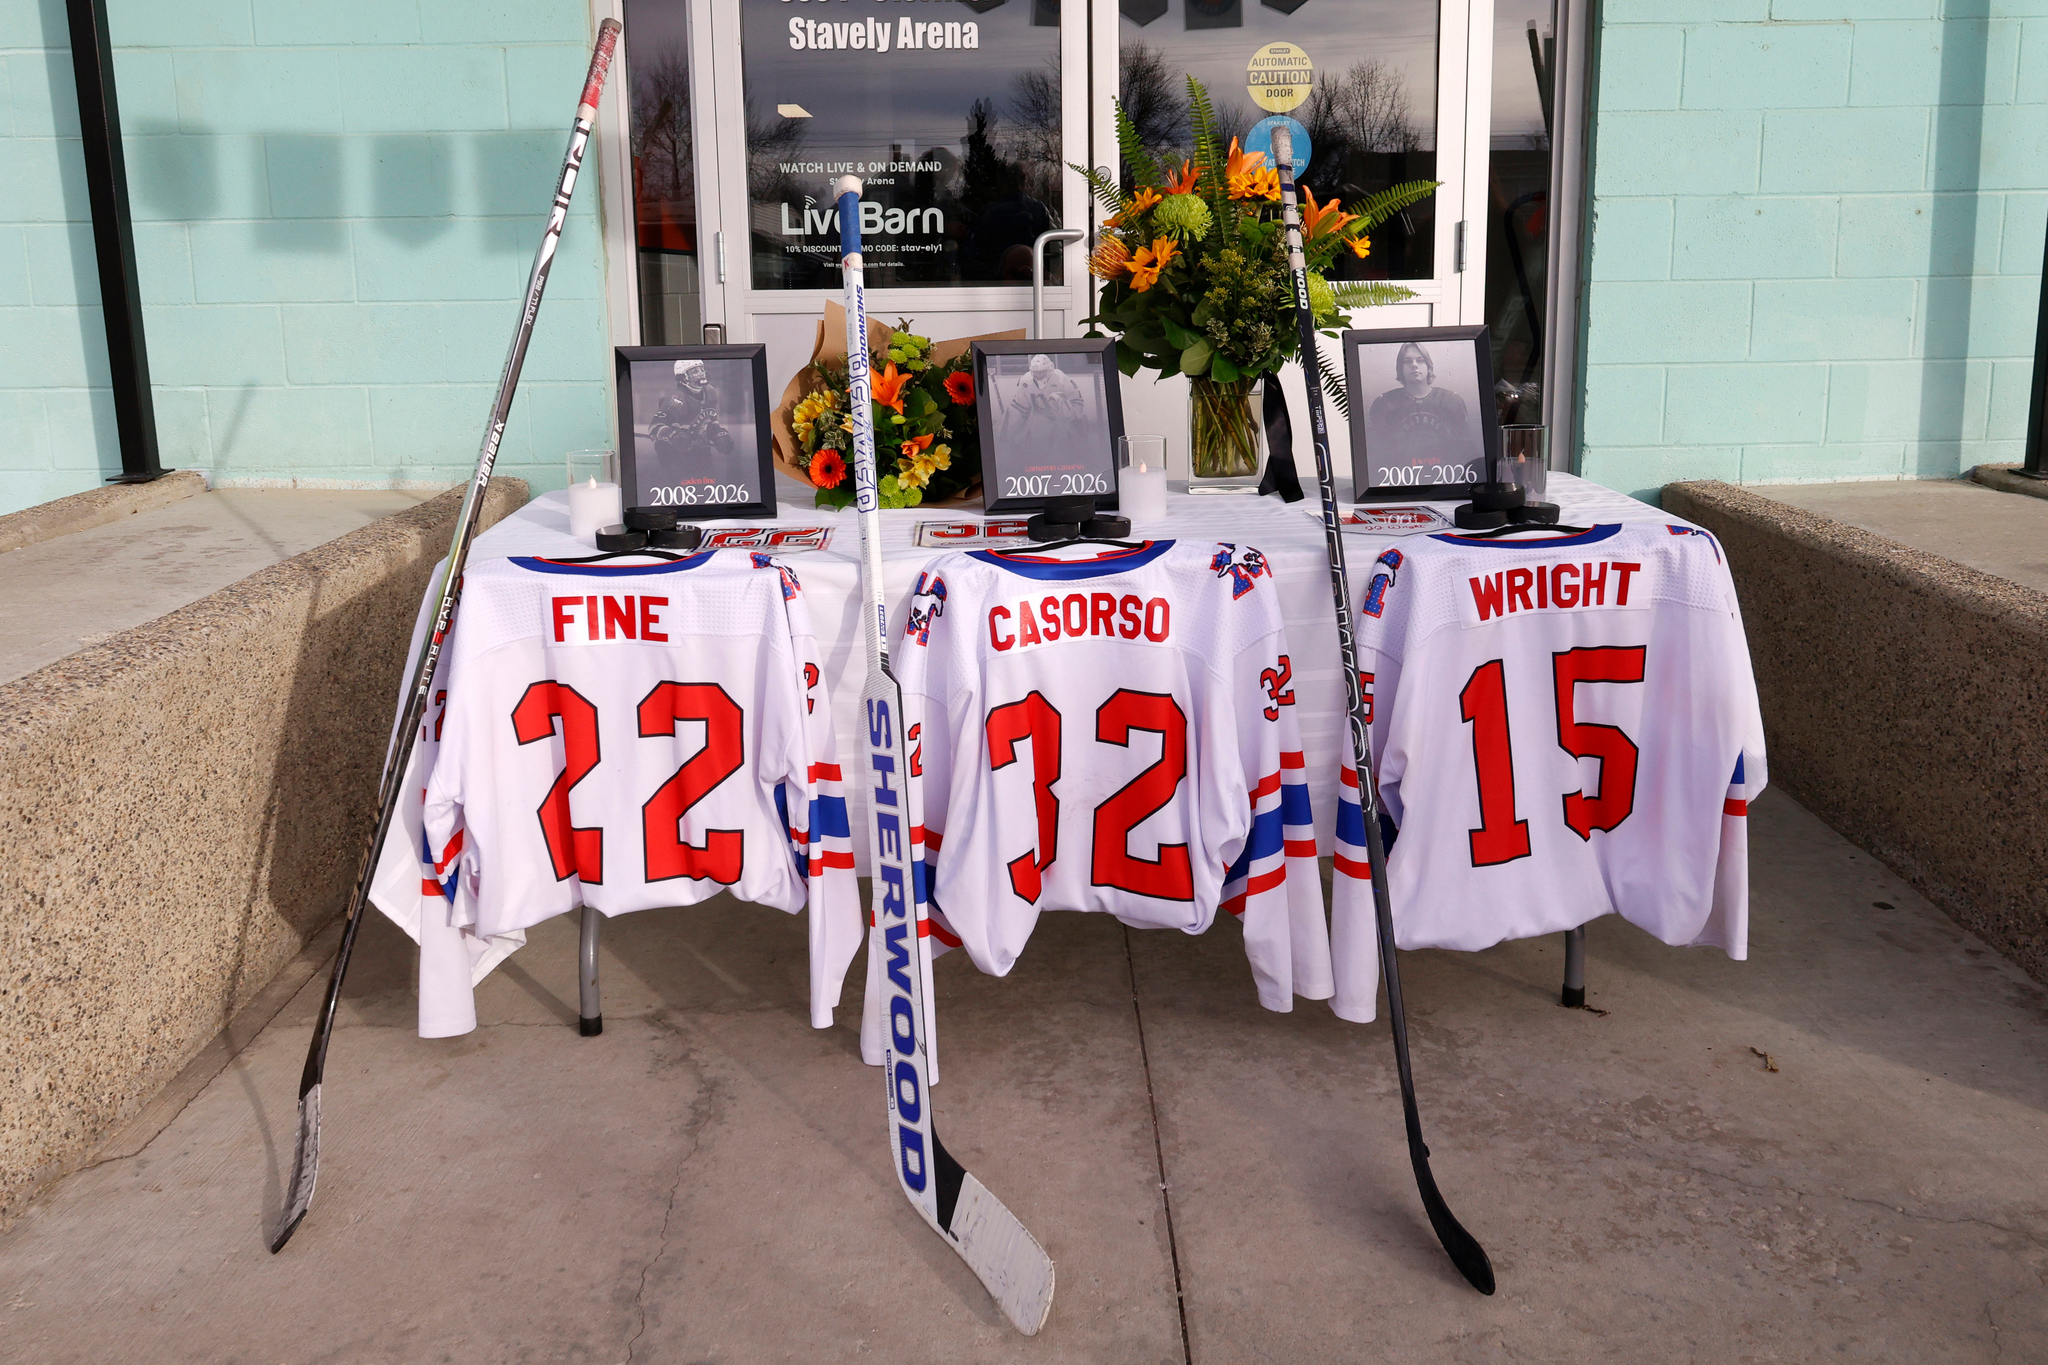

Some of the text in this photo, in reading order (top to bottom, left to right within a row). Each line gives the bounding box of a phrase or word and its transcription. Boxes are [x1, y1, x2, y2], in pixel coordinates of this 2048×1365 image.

[789, 16, 979, 53] Stavely Arena
[1249, 70, 1310, 84] CAUTION
[1252, 57, 1307, 67] AUTOMATIC
[1266, 88, 1293, 97] DOOR
[779, 161, 942, 173] WATCH LIVE & ON DEMAND
[785, 245, 801, 253] 10%
[803, 245, 842, 253] DISCOUNT
[875, 244, 899, 252] CODE:
[855, 283, 868, 369] SHERWOOD
[650, 483, 749, 506] 2008-2026
[1005, 473, 1108, 497] 2007-2026
[1378, 464, 1477, 486] 2007-2026
[1468, 561, 1641, 621] WRIGHT
[551, 595, 669, 643] FINE
[988, 592, 1170, 652] CASORSO
[418, 595, 454, 696] HYPERLITE
[1260, 654, 1296, 722] 32
[1459, 644, 1647, 868] 15
[511, 679, 744, 885] 22
[985, 688, 1195, 906] 32
[866, 698, 927, 1194] SHERWOOD
